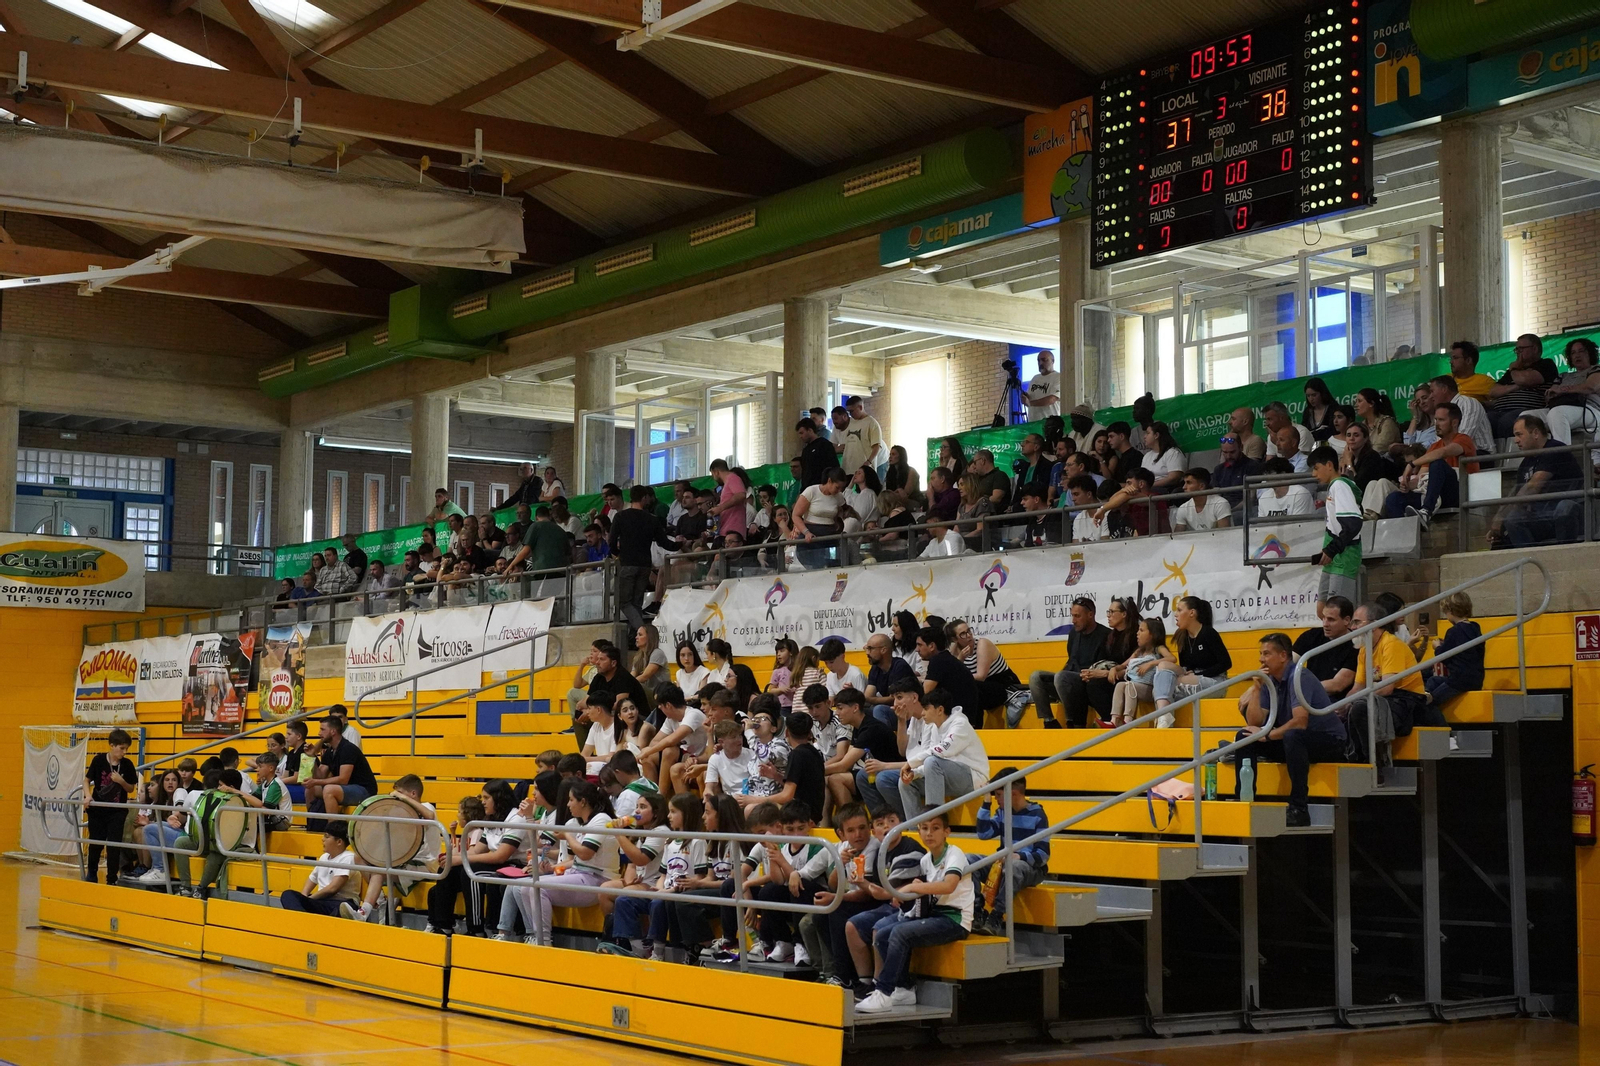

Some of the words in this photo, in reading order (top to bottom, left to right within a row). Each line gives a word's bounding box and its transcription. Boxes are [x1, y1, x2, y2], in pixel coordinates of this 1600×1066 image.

[1304, 13, 1311, 25] 4
[1304, 31, 1311, 42] 5
[1191, 35, 1252, 79] 09:53
[1304, 47, 1311, 59] 6
[1249, 62, 1288, 85] VISITANTE
[1304, 64, 1310, 76] 7
[1100, 80, 1106, 91] 4
[1303, 81, 1310, 93] 8
[1100, 95, 1106, 107] 5
[1162, 92, 1198, 113] LOCAL
[1260, 88, 1287, 122] 38
[1303, 98, 1310, 110] 9
[1216, 96, 1227, 119] 3
[1100, 111, 1106, 122] 6
[1299, 115, 1310, 128] 10
[1100, 126, 1106, 137] 7
[1167, 117, 1190, 149] 37
[1208, 122, 1236, 139] PERIODO
[1028, 128, 1066, 157] marcha
[1272, 129, 1295, 145] FALTA
[1301, 132, 1310, 145] 11
[1099, 142, 1106, 153] 8
[1223, 140, 1258, 159] JUGADOR
[1191, 152, 1213, 167] FALTA
[1281, 147, 1293, 171] 0
[1300, 150, 1310, 162] 12
[1099, 157, 1106, 169] 9
[1149, 161, 1182, 179] JUGADOR
[1225, 160, 1247, 186] 00
[1300, 167, 1310, 179] 13
[1096, 173, 1105, 184] 10
[1202, 169, 1213, 192] 0
[1097, 189, 1105, 199] 11
[1300, 184, 1310, 196] 14
[1225, 188, 1253, 205] FALTAS
[1096, 204, 1104, 215] 12
[1300, 201, 1310, 214] 15
[1149, 207, 1176, 224] FALTAS
[1236, 206, 1248, 230] 0
[926, 212, 993, 245] cajamar
[1096, 220, 1104, 231] 13
[1096, 235, 1104, 247] 14
[1095, 251, 1104, 262] 15
[1186, 413, 1232, 430] INAGRO
[1196, 427, 1229, 438] BIOTECH
[0, 553, 98, 571] Cualin
[240, 552, 261, 561] ASEOS
[31, 570, 85, 578] INTEGRAL
[83, 589, 133, 599] TECNICO
[36, 596, 59, 604] 950
[65, 597, 105, 606] 497711
[814, 606, 855, 619] DIPUTACIÓN
[1045, 608, 1056, 619] DE
[815, 622, 824, 631] DE
[825, 619, 853, 630] ALMERÍA
[431, 636, 468, 658] fircosa
[347, 645, 380, 665] Audasa
[79, 649, 138, 684] EJIDOMAR
[152, 670, 162, 680] LOS
[272, 673, 290, 684] GRUPO
[271, 691, 290, 707] OTTO
